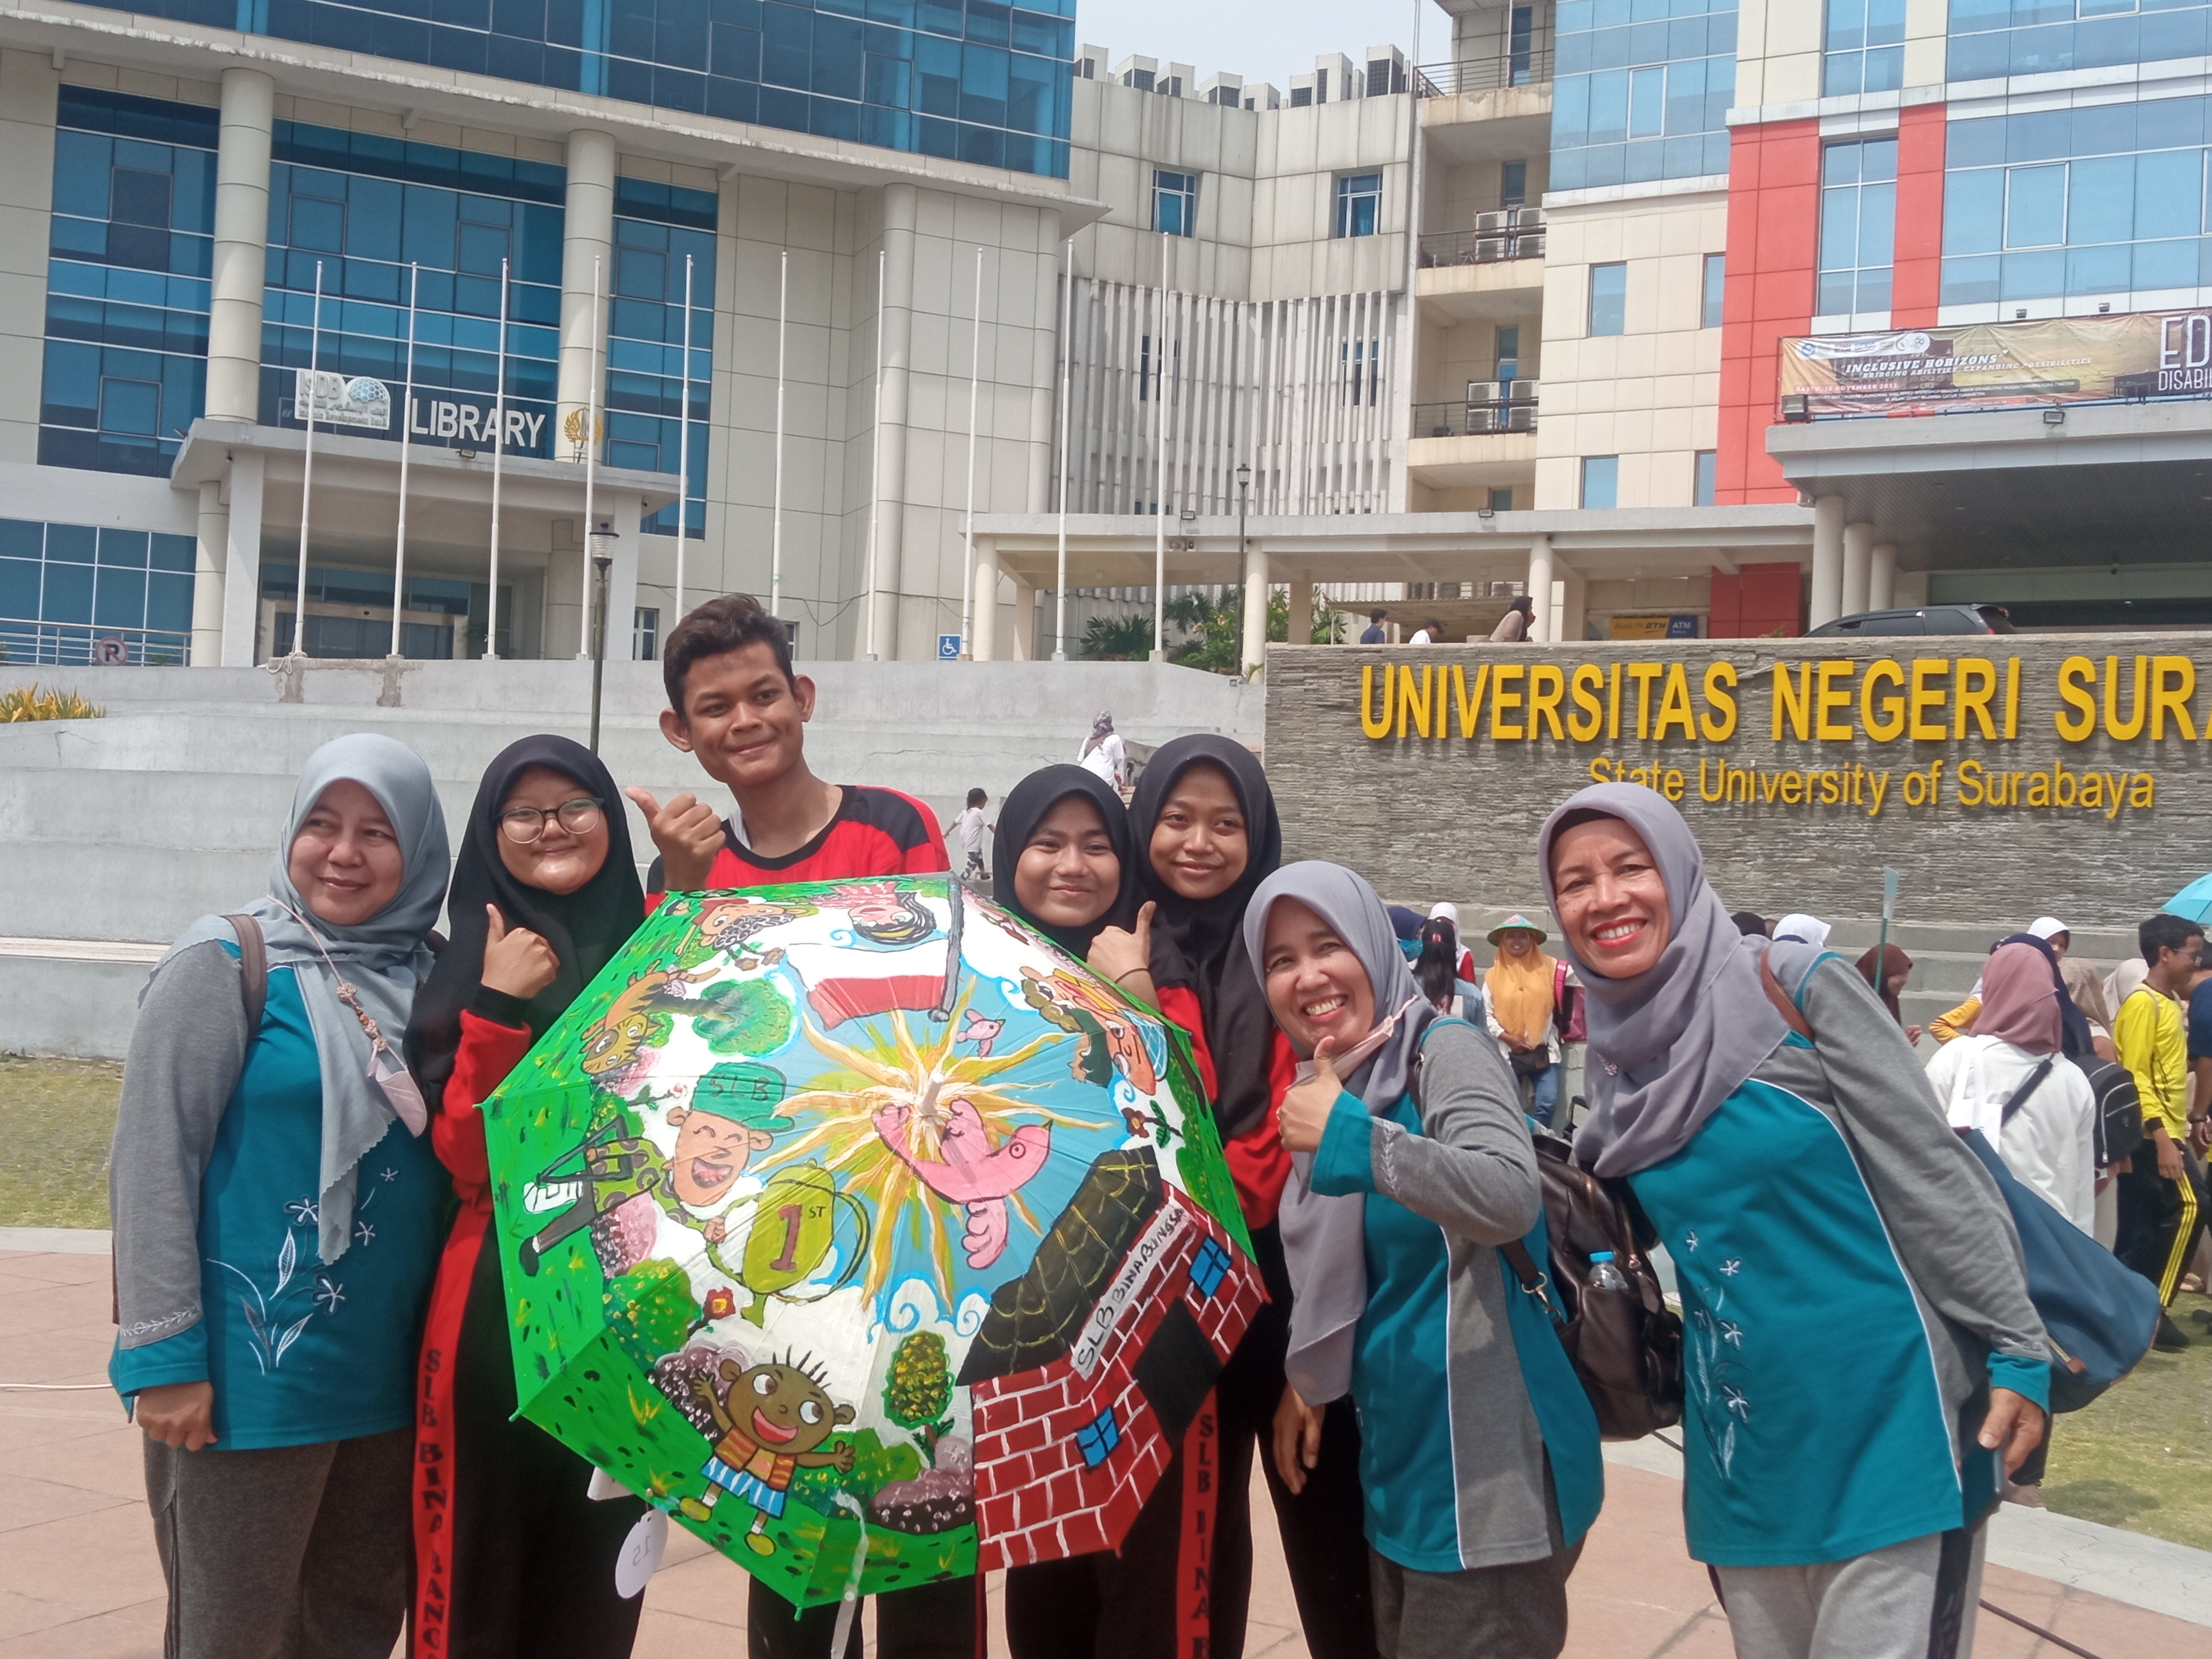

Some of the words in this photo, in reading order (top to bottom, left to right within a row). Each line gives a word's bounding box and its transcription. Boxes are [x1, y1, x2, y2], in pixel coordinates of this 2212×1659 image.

[1964, 363, 2019, 372] EXPANDING
[2023, 358, 2093, 369] POSSIBILITIES
[411, 398, 546, 448] LIBRARY
[1360, 661, 1739, 742] UNIVERSITAS
[1771, 657, 2021, 742] NEGERI
[2054, 655, 2212, 742] SUR
[1698, 758, 1890, 817] University
[1903, 759, 1945, 807] of
[1958, 759, 2155, 819] Surabaya
[708, 1073, 770, 1101] SLB
[1077, 1305, 1114, 1371] SLB
[1196, 1414, 1214, 1494] SLB
[423, 1547, 446, 1659] BANG
